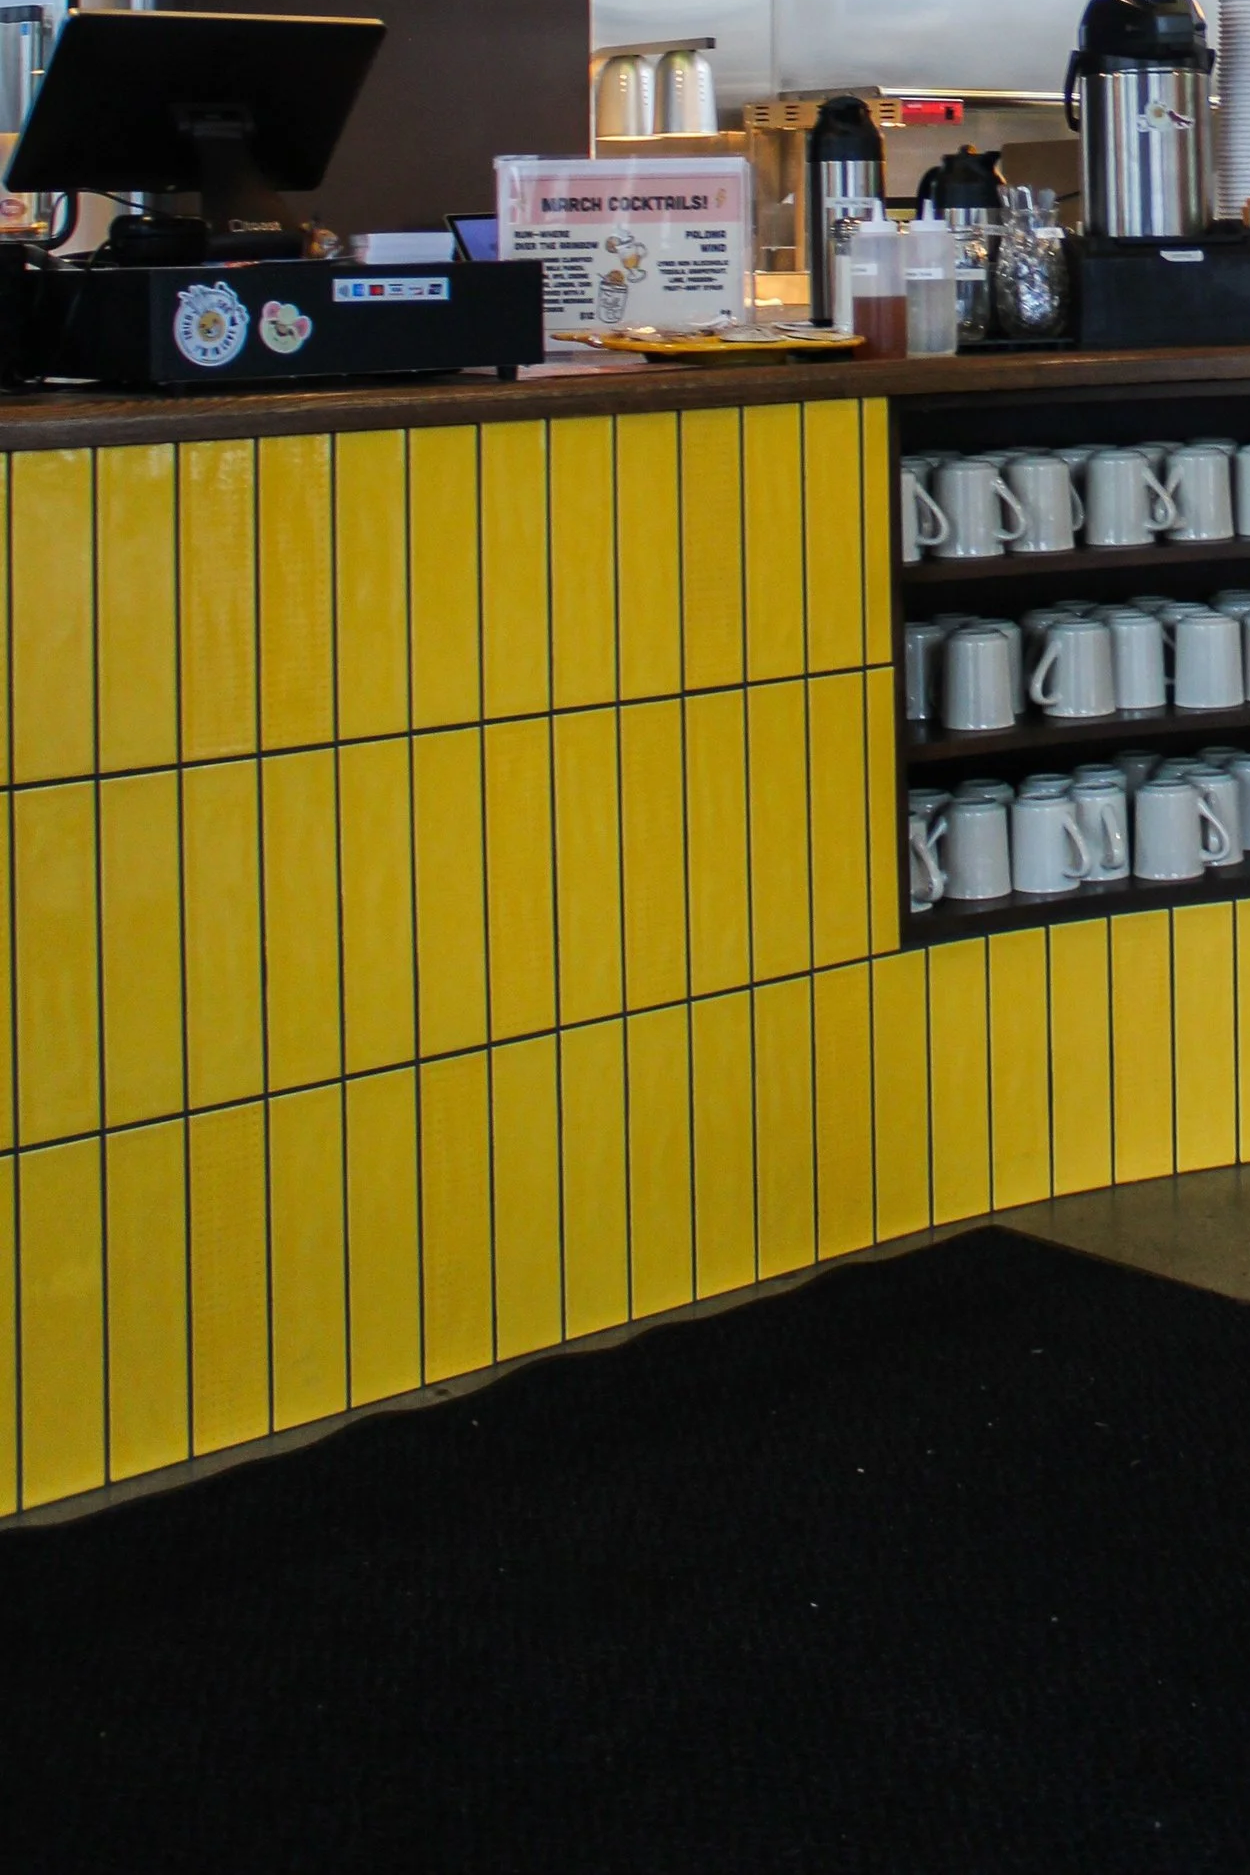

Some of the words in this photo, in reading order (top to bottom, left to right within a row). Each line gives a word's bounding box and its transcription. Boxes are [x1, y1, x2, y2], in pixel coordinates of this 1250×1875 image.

[541, 196, 602, 212] MARCH
[608, 195, 708, 211] COCKTAILS!
[685, 230, 726, 238] PALOMA
[701, 244, 726, 252] WIND
